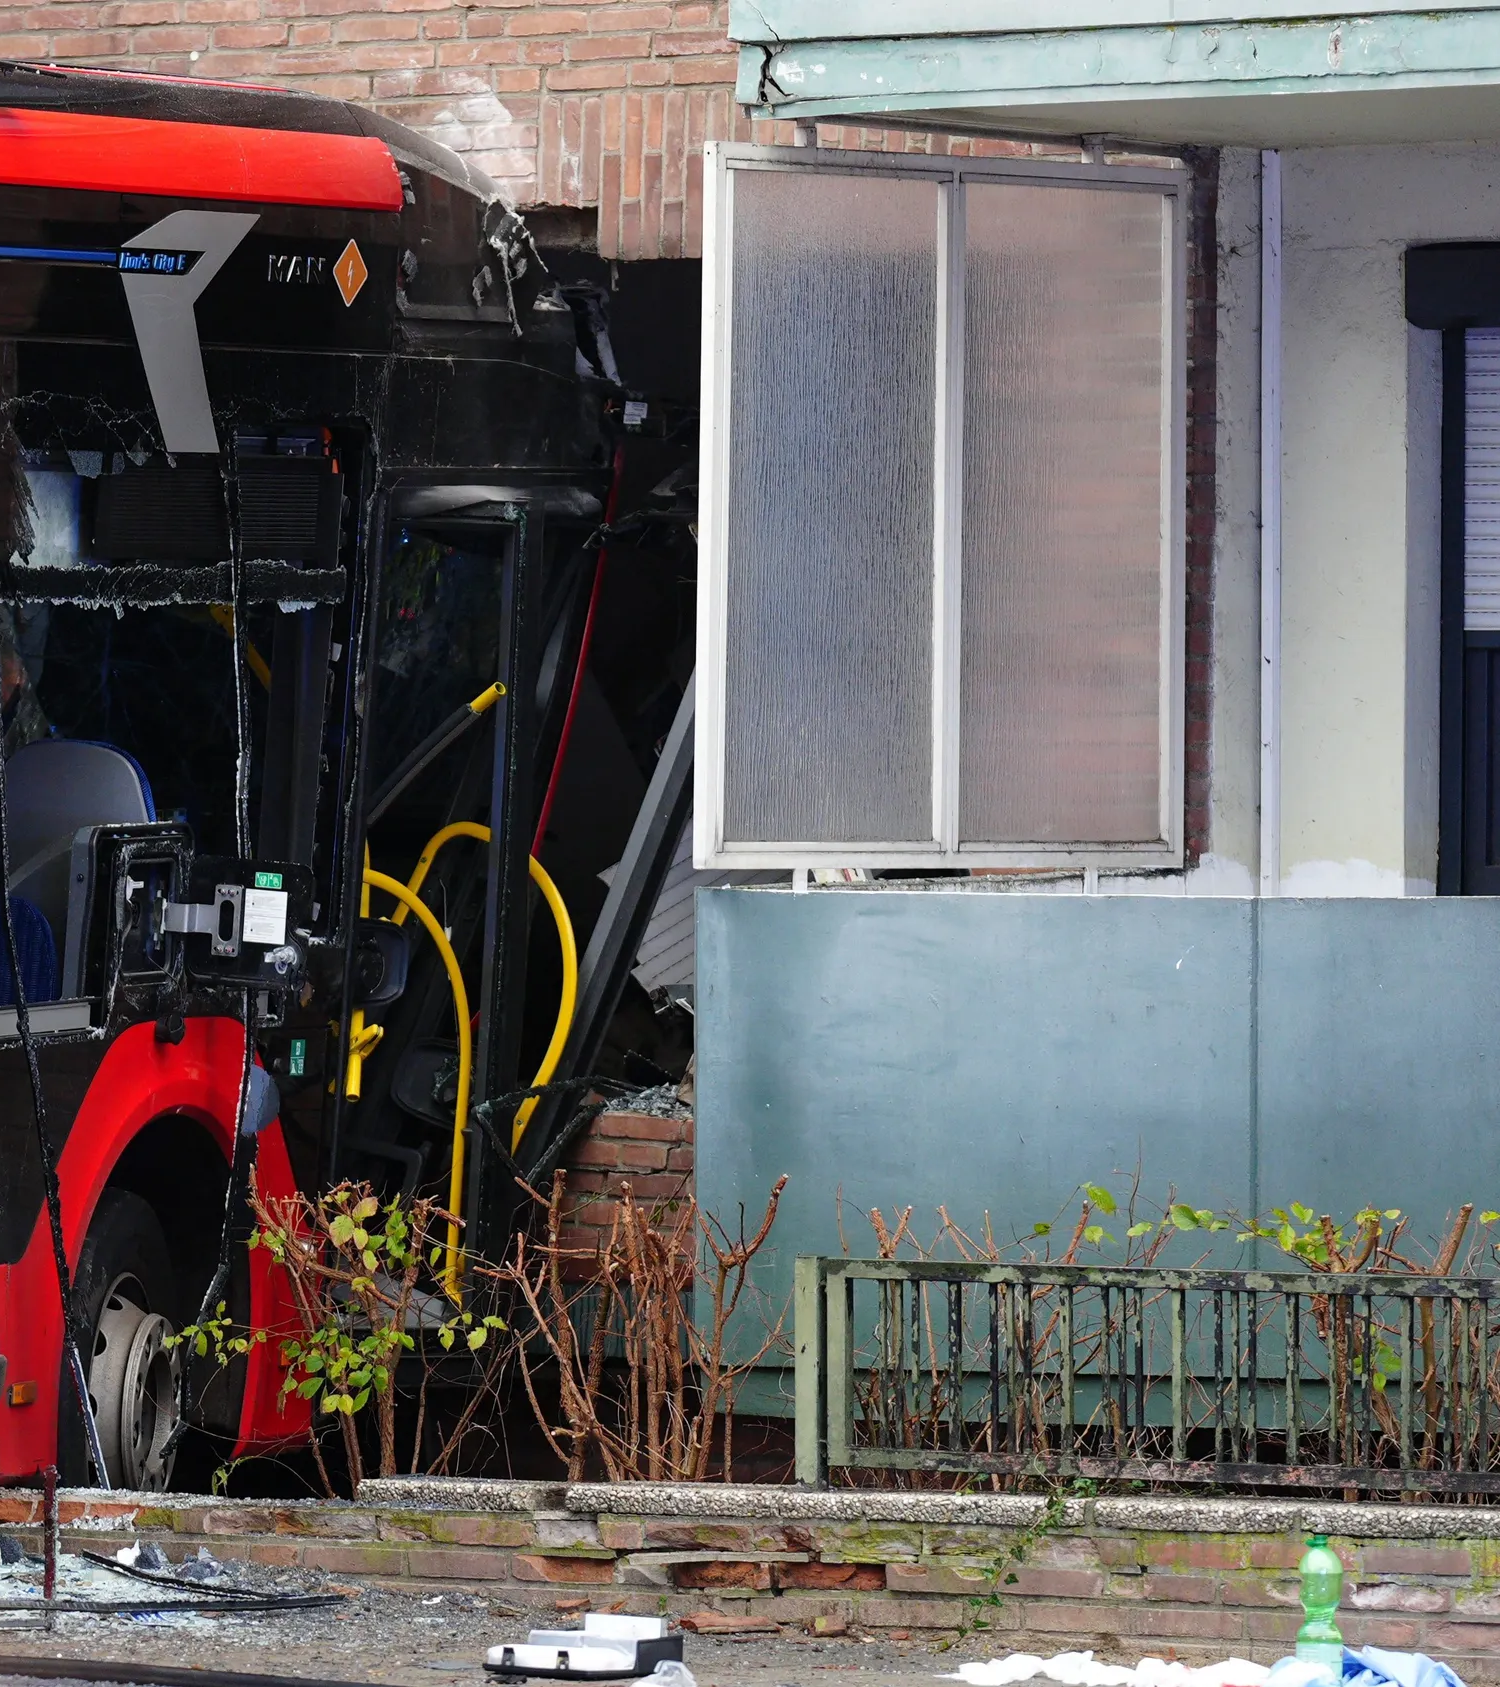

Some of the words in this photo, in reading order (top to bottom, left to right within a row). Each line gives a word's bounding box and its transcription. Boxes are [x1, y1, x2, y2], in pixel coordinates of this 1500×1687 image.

[119, 252, 151, 269] Lion's
[153, 254, 175, 273] City
[177, 254, 186, 270] E
[268, 255, 326, 284] MAN
